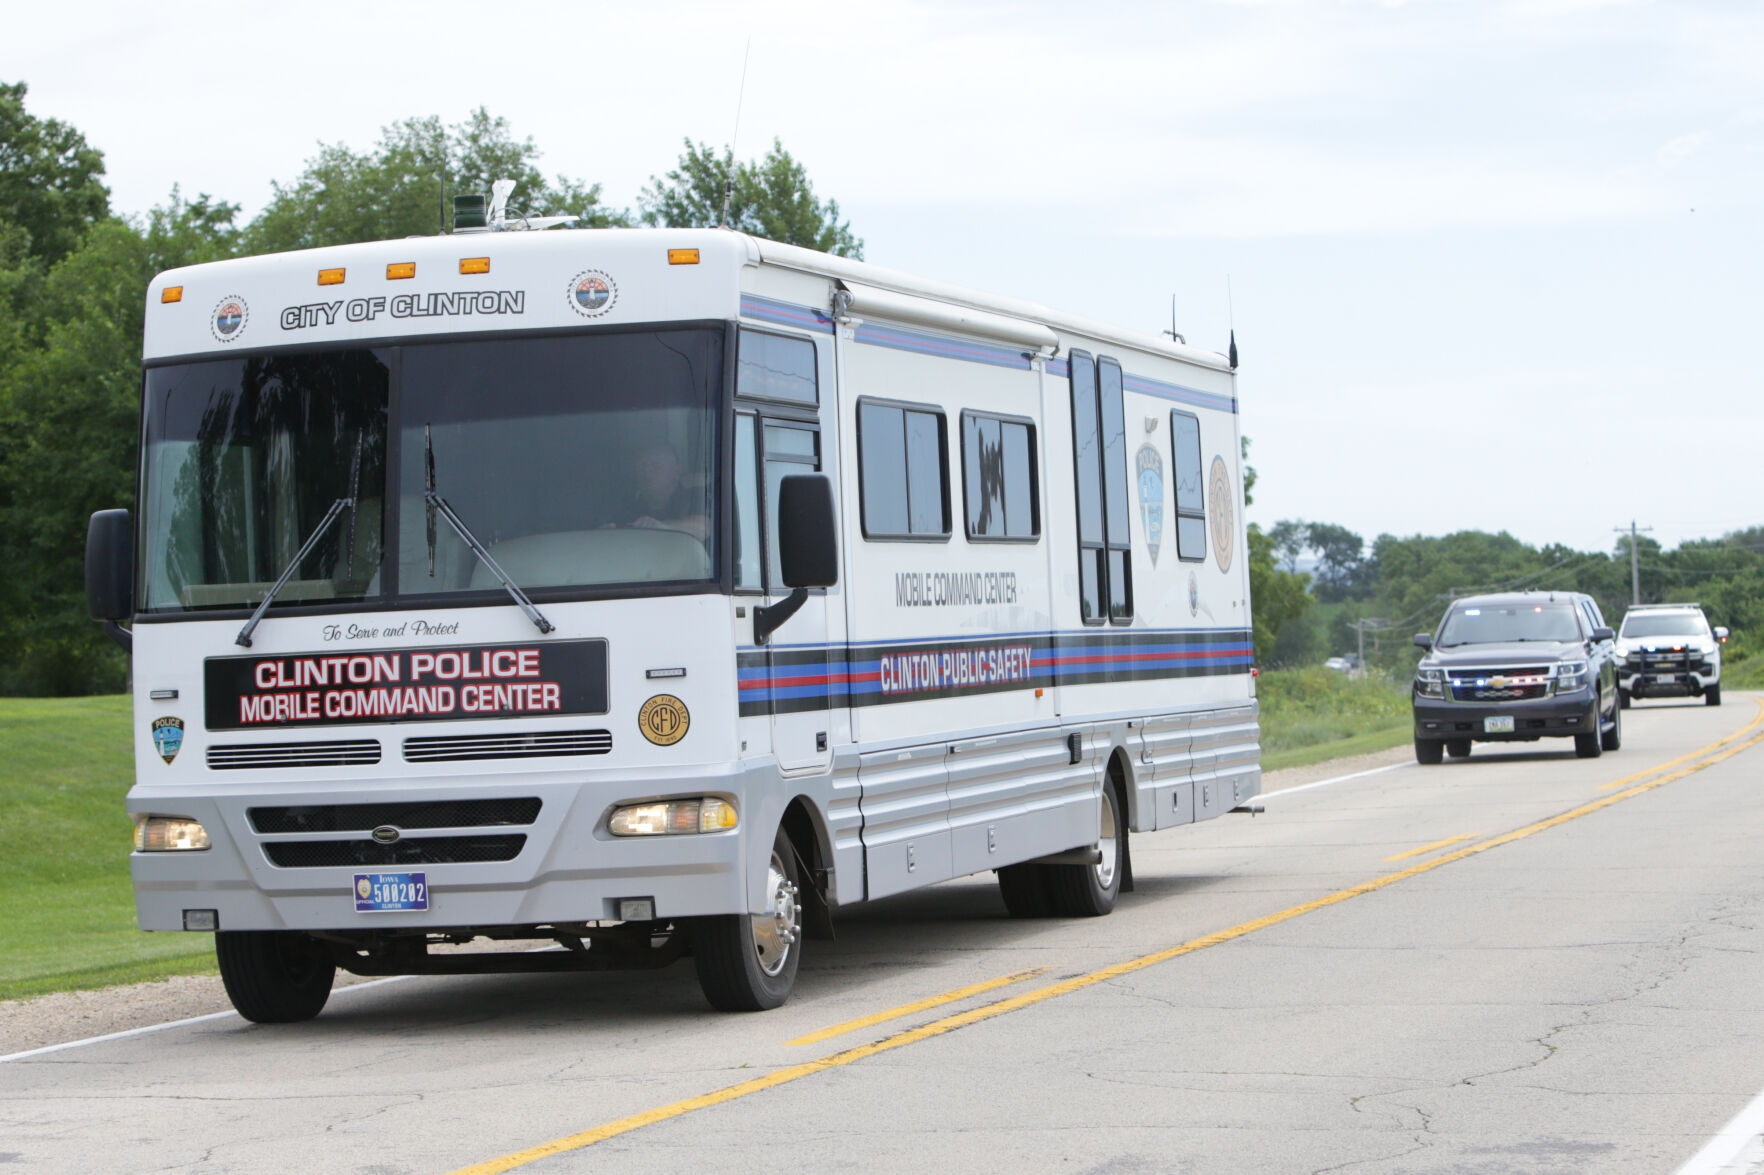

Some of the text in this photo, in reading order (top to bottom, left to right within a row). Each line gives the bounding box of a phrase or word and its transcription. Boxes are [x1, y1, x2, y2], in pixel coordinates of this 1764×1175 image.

[280, 291, 525, 330] CITY OF CLINTON
[895, 572, 1017, 607] MOBILE COMMAND CENTER
[323, 620, 459, 641] To Serve and Protect
[255, 649, 541, 689] CLINTON POLICE
[881, 644, 1032, 695] CLINTON PUBLIC SAFETY
[240, 681, 561, 723] MOBILE COMMAND CENTER
[662, 697, 677, 706] FIRE
[155, 718, 180, 729] POLICE
[651, 706, 677, 733] CFD
[374, 883, 424, 902] 500202
